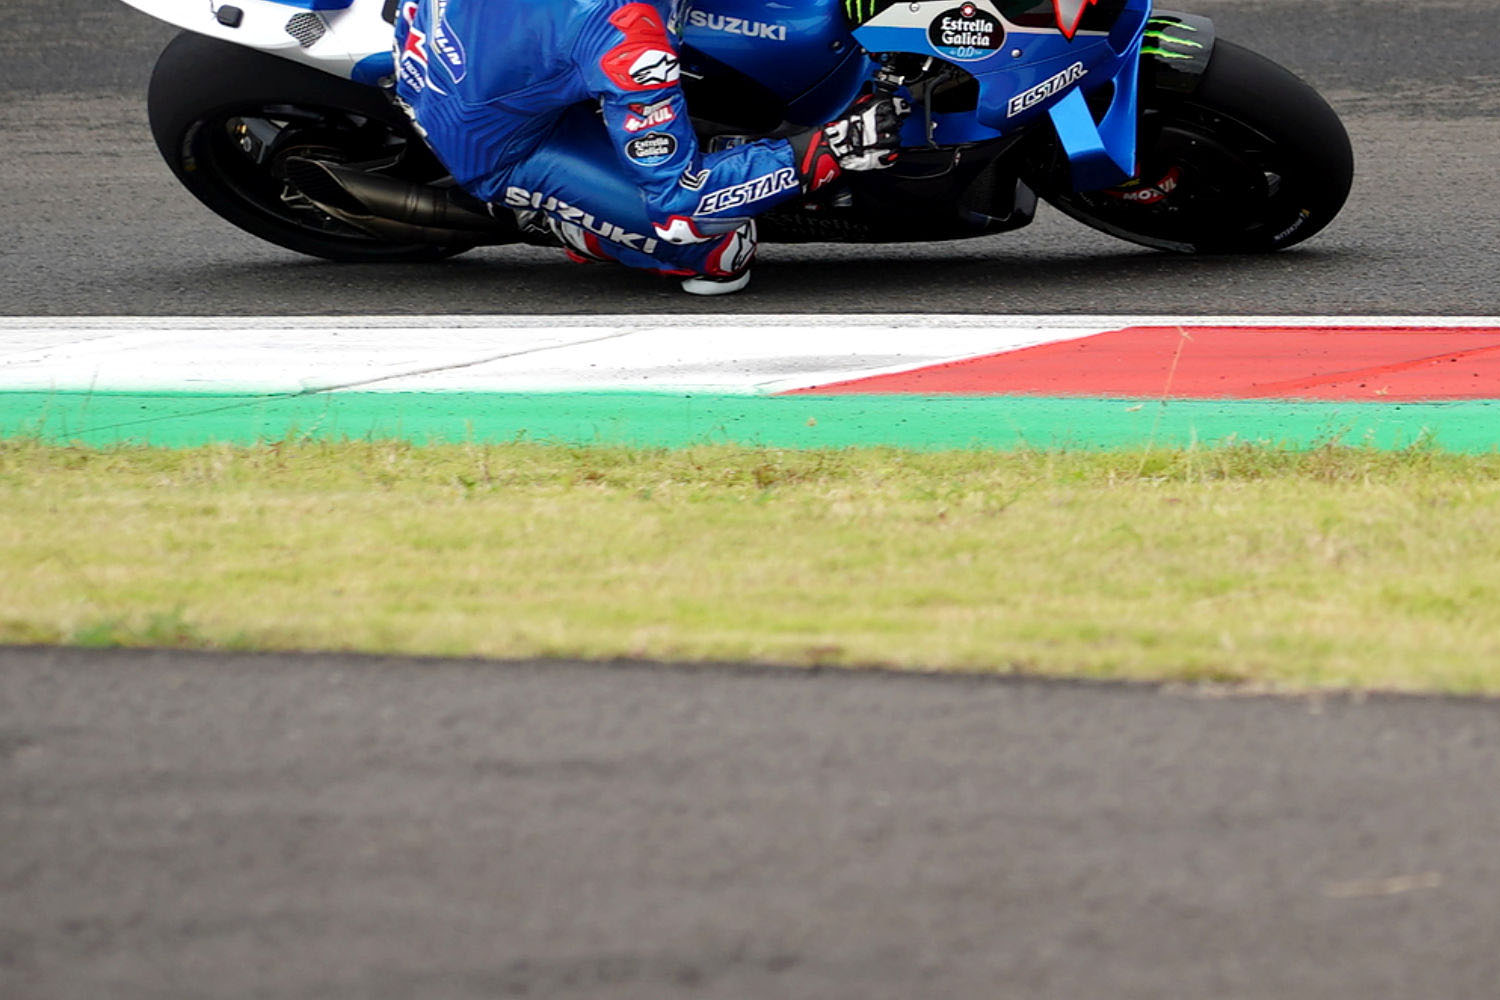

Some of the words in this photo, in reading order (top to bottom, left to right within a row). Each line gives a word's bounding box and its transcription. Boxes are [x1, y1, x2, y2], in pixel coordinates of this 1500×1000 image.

[689, 10, 787, 41] SUZUKI
[940, 16, 994, 34] Estrella
[941, 30, 991, 47] Galicia
[1007, 60, 1089, 118] ECSTAR
[693, 166, 800, 216] ECSTAR
[504, 185, 659, 255] SUZUKI
